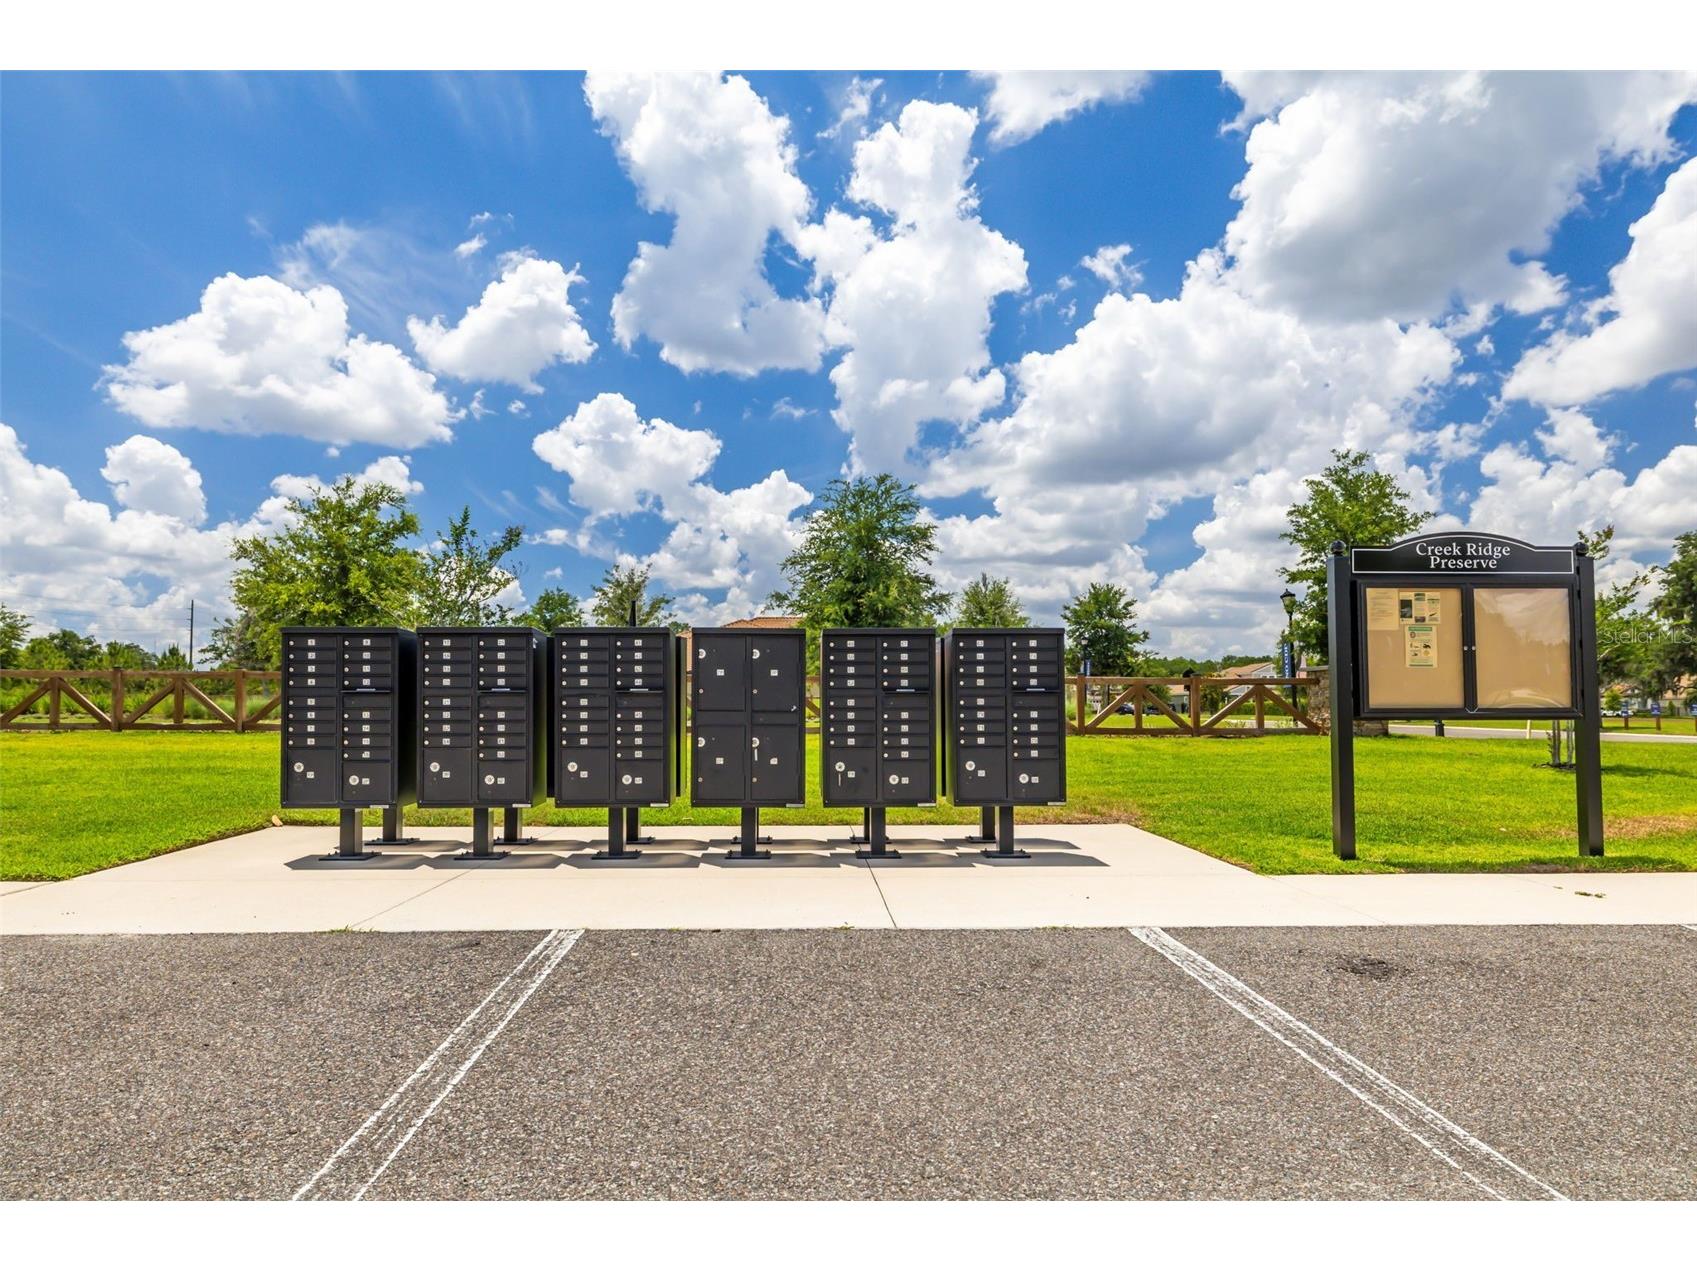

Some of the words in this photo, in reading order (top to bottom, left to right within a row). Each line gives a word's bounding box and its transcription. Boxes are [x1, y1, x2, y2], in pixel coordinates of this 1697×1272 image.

[1415, 542, 1462, 556] Creek
[1466, 542, 1511, 559] Ridge
[1429, 556, 1497, 569] Preserve
